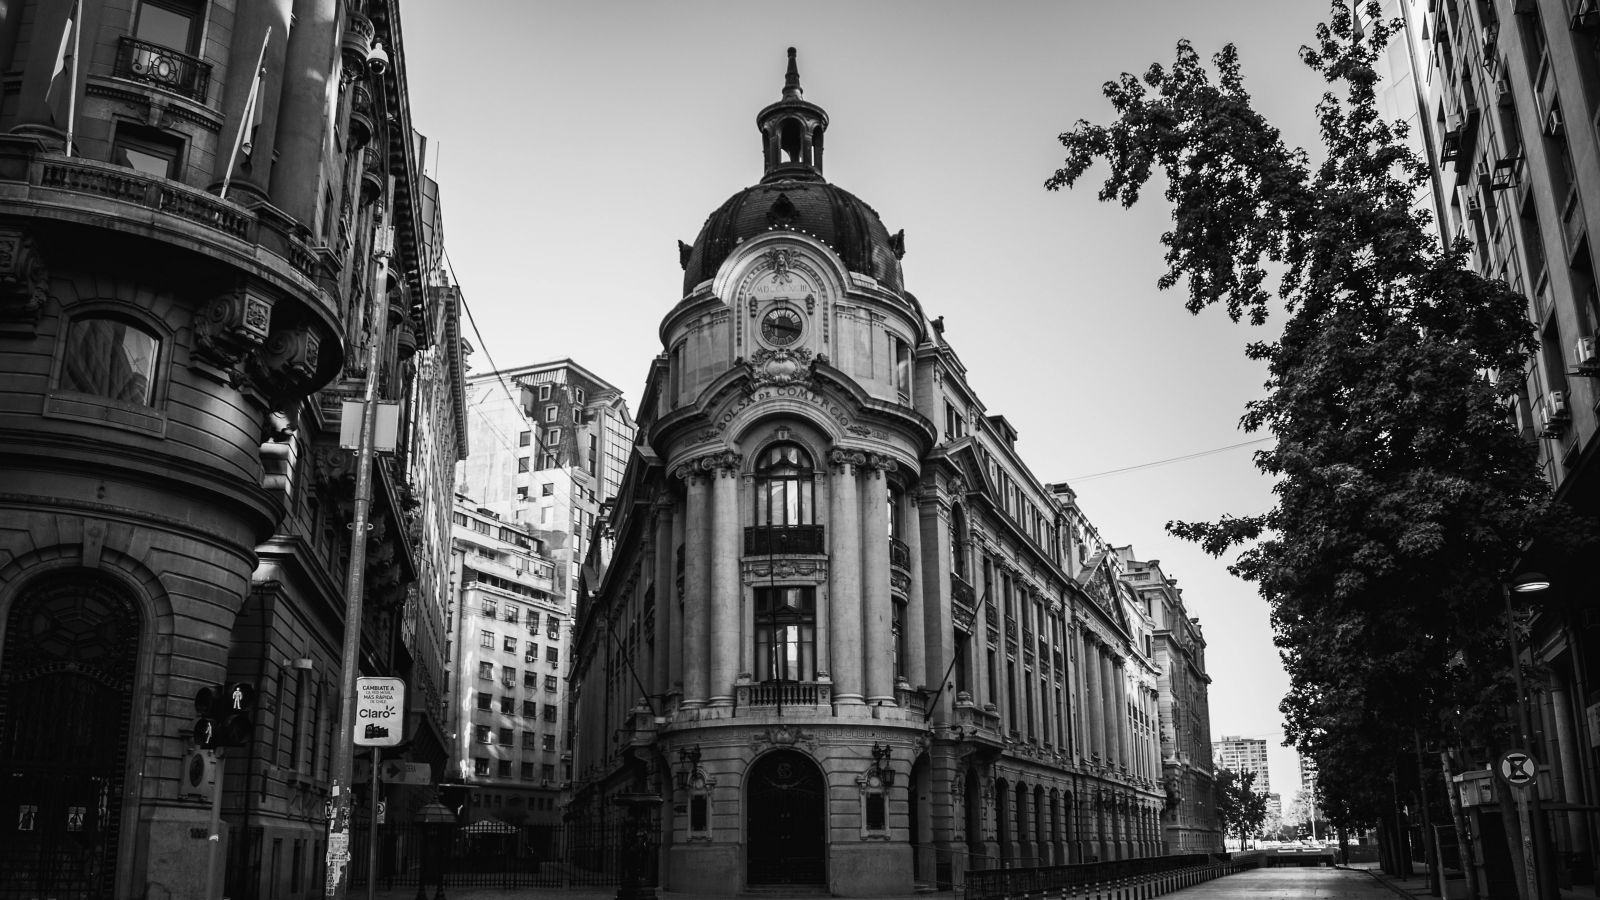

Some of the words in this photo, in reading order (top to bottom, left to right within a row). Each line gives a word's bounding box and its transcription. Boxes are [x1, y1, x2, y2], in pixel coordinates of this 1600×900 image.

[717, 396, 756, 431] BOLSA
[777, 387, 849, 427] COMERCIO
[359, 707, 392, 719] Claro
